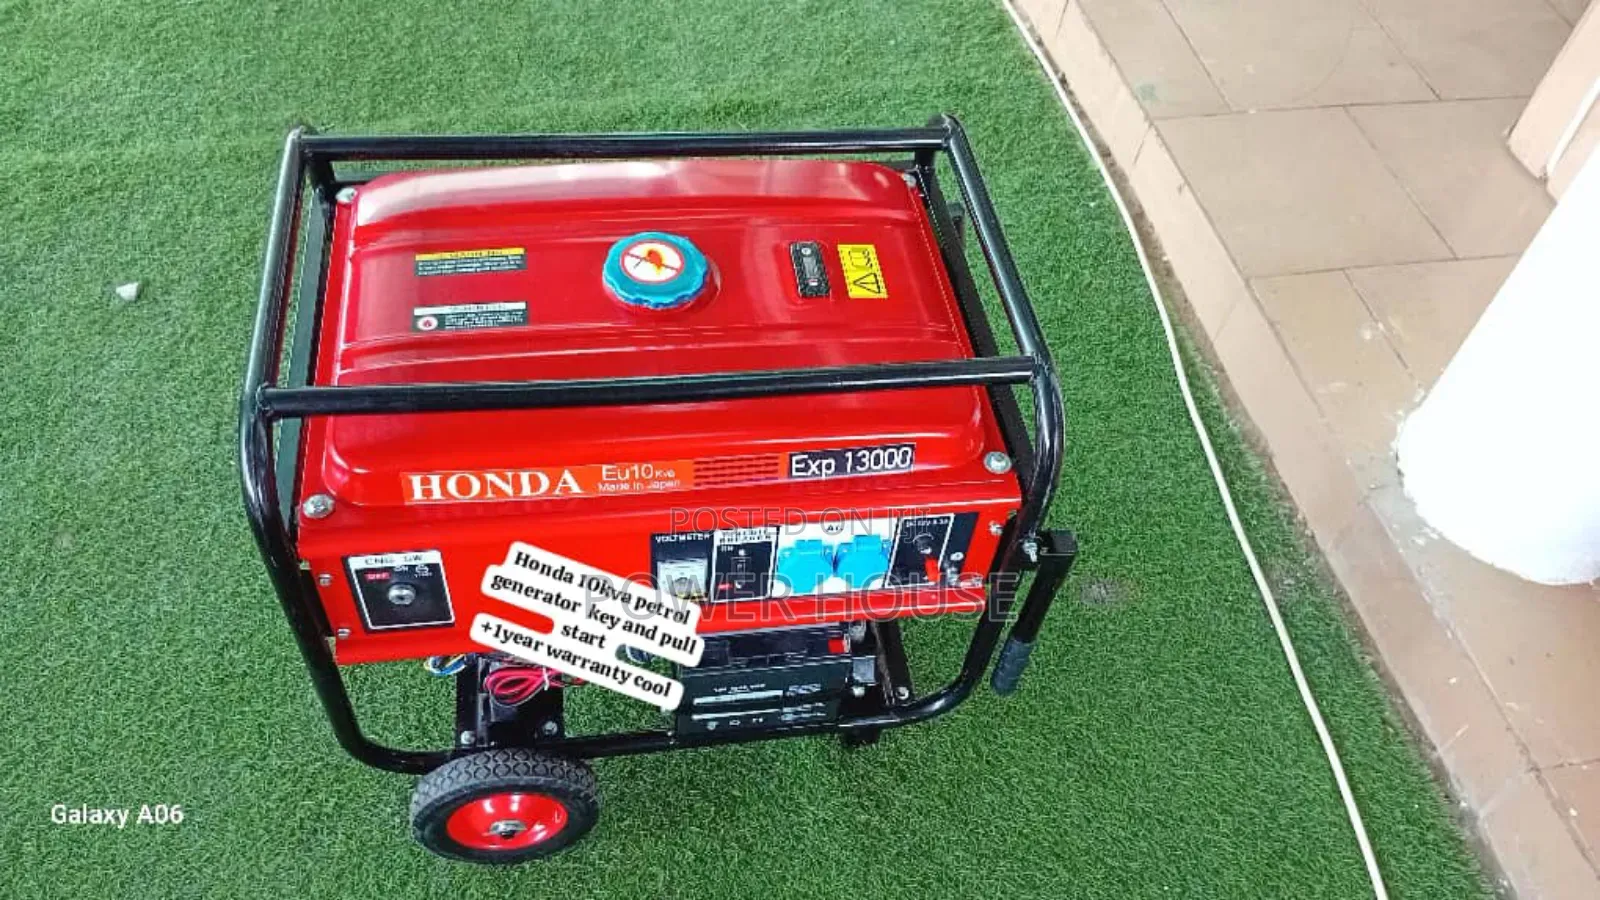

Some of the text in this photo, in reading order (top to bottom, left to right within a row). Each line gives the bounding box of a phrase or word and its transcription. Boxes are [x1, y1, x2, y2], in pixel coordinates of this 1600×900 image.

[791, 446, 912, 480] Exp 13000
[408, 469, 583, 500] HONDA
[602, 463, 653, 480] Eu10
